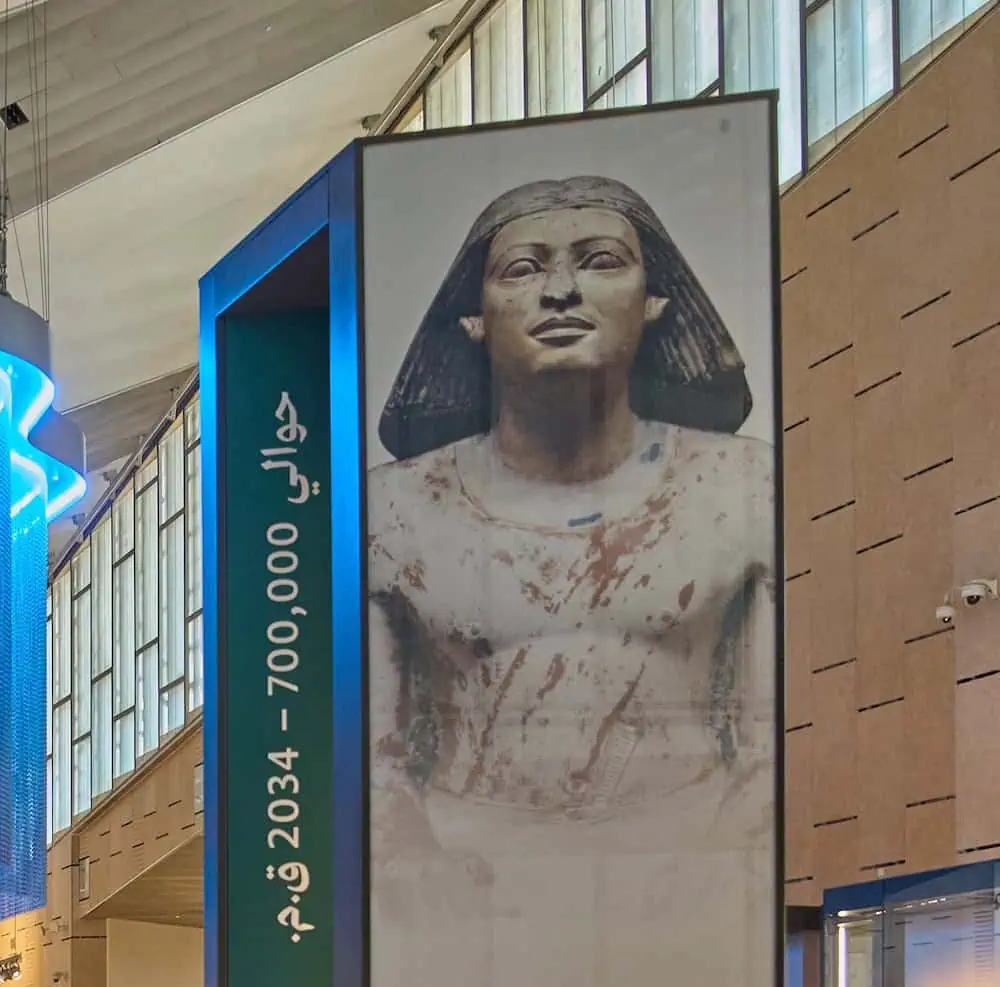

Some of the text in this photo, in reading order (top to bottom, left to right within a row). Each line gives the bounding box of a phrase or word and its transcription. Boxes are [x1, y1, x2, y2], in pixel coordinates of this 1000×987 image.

[260, 391, 320, 504] حوالي
[266, 522, 307, 696] 700,000
[266, 747, 300, 849] 2034
